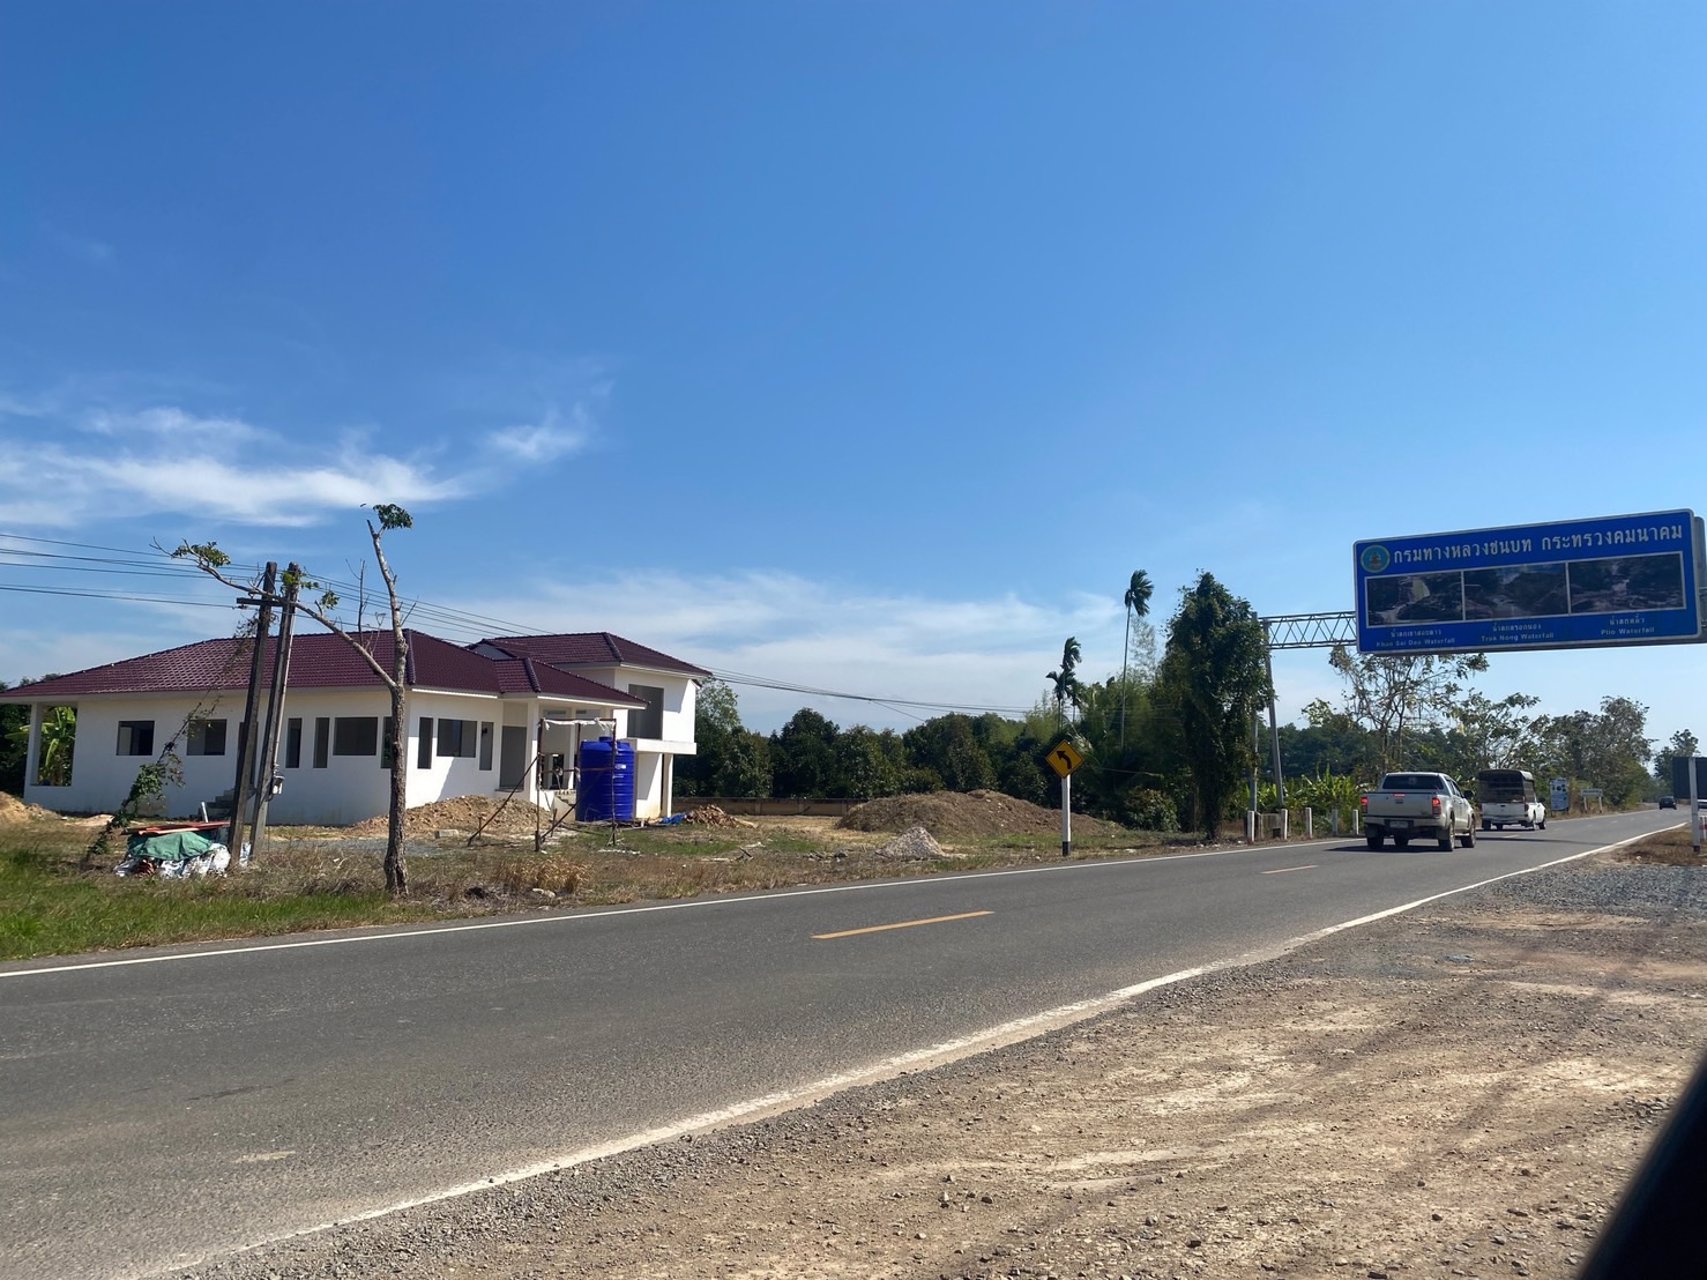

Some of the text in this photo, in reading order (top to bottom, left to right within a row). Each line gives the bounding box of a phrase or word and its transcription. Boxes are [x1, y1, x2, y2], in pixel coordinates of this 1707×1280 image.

[1394, 525, 1682, 563] กรมทางหลวงชนบท กระทรวงคมนาคม
